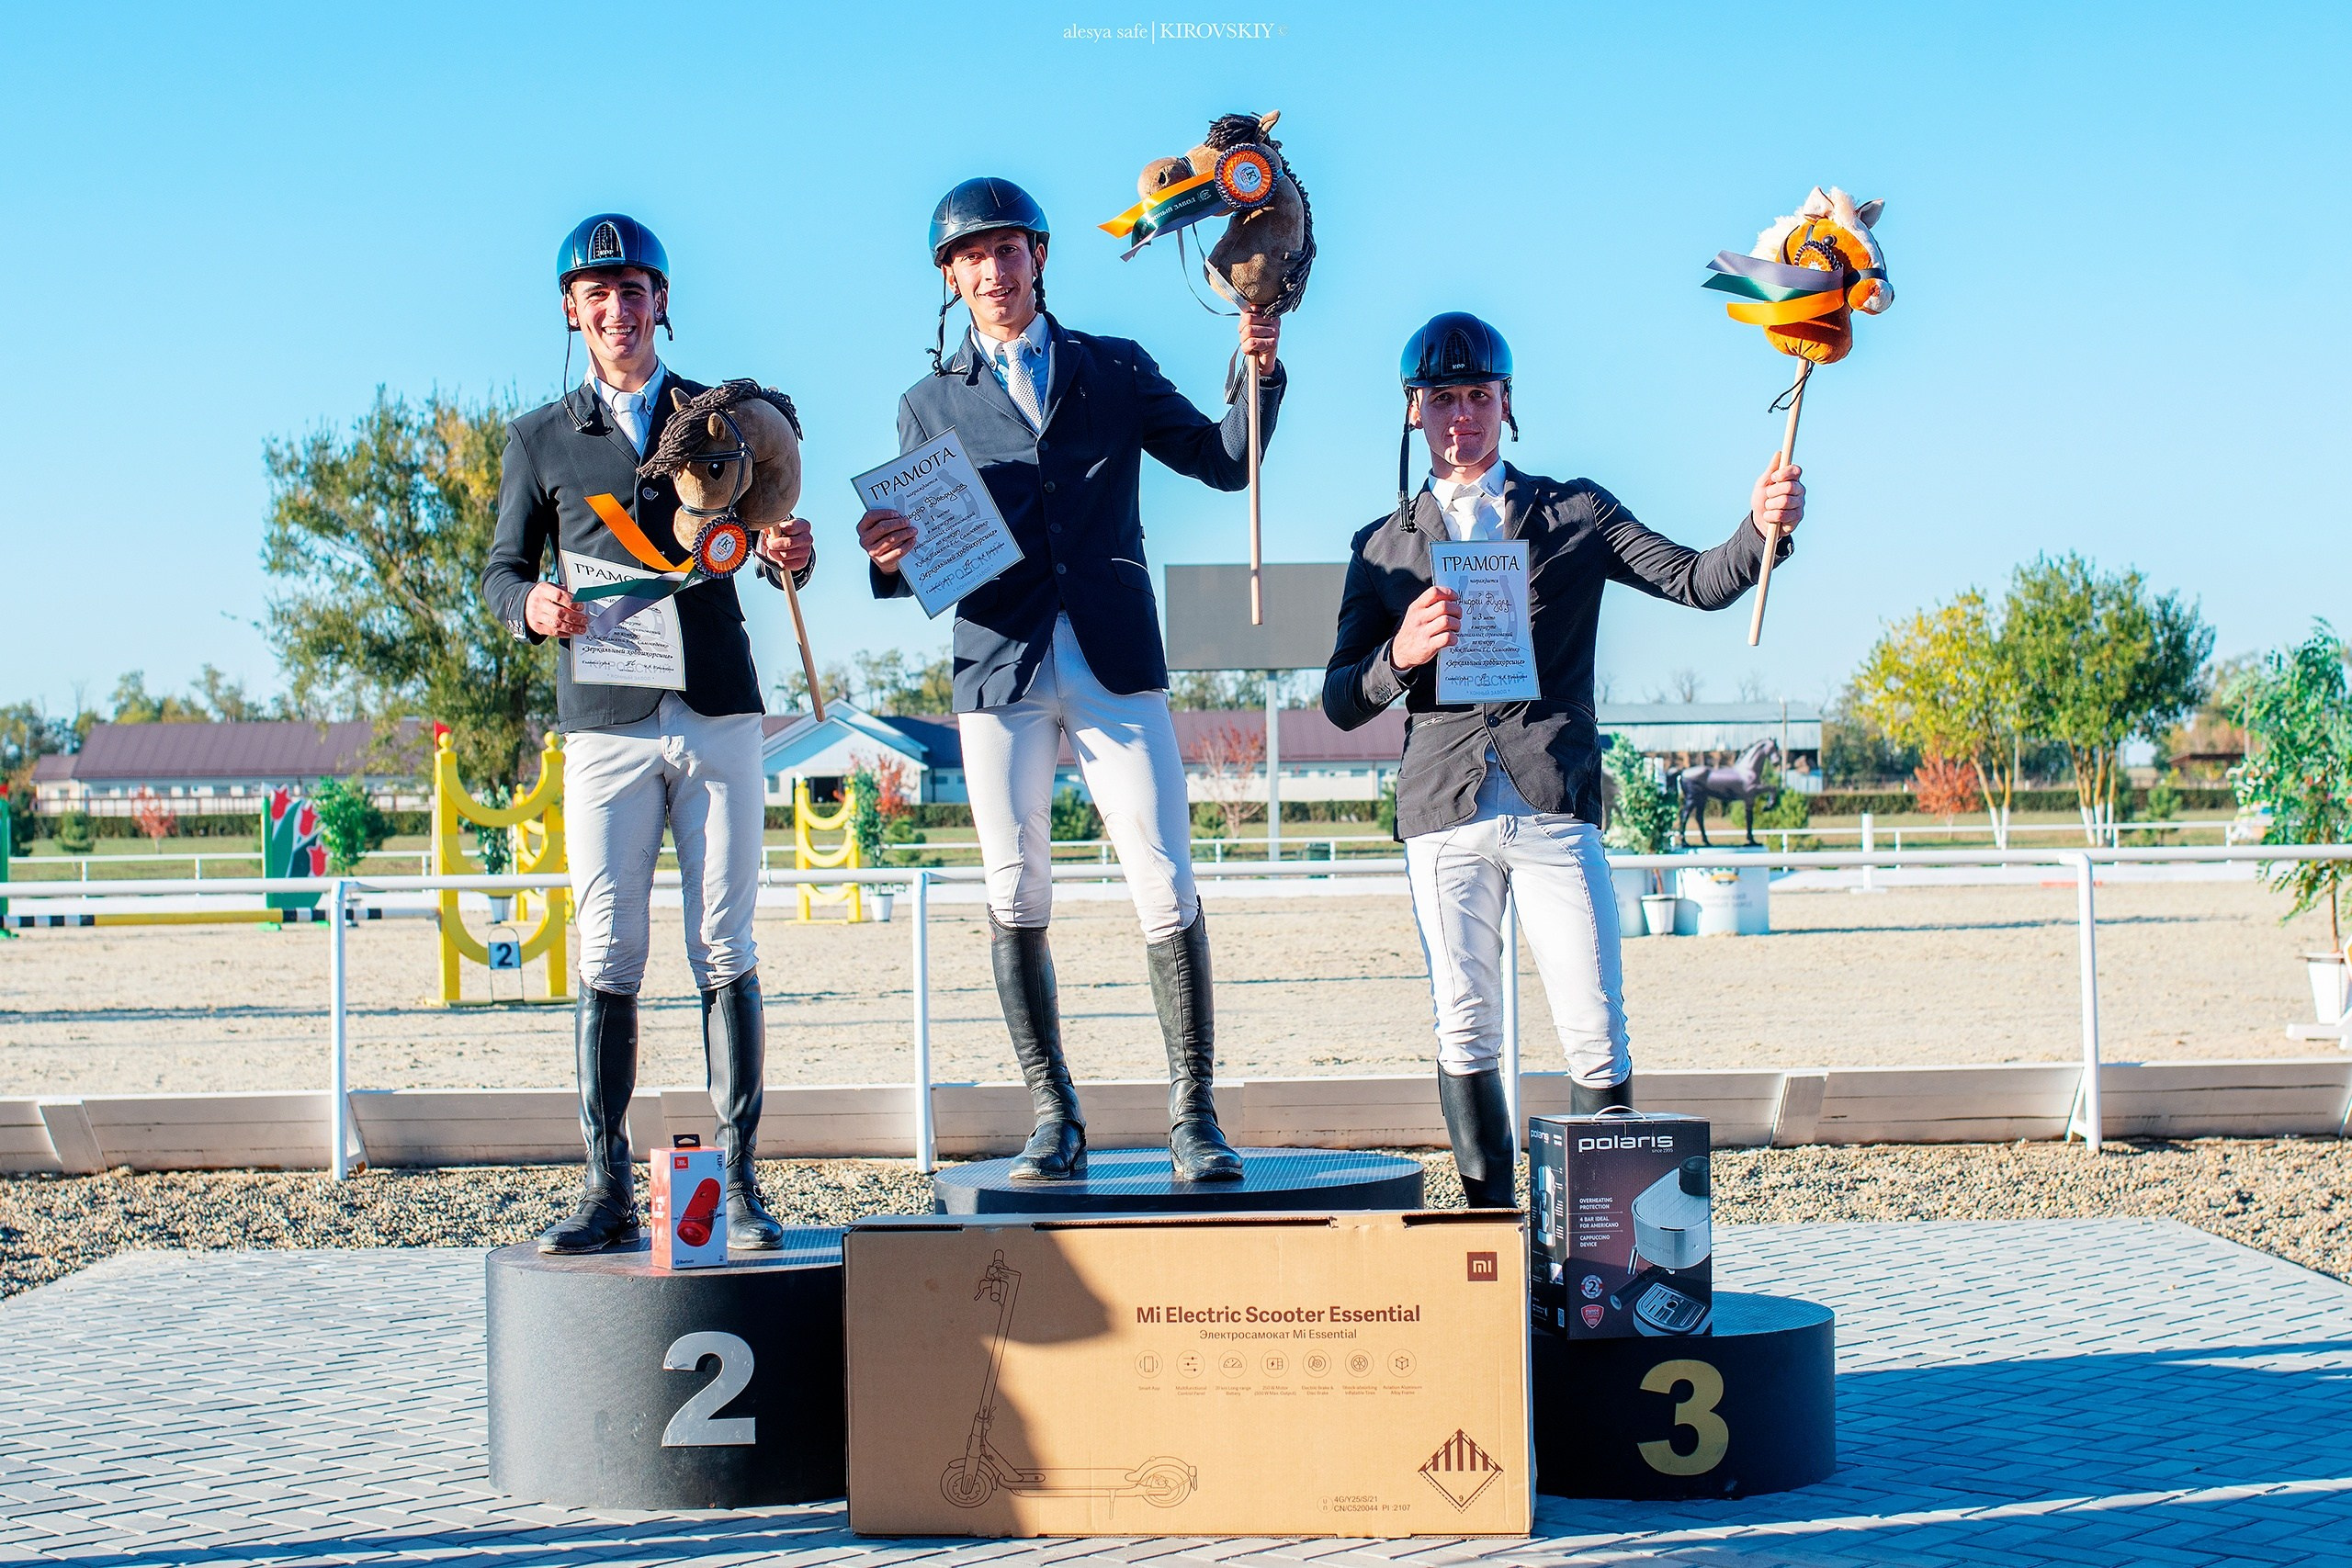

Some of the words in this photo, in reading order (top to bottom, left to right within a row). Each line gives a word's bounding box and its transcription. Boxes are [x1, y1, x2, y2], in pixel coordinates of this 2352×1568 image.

[869, 446, 956, 501] ГРАМОТА
[574, 563, 636, 582] ГРАМО
[1442, 555, 1521, 571] ГРАМОТА
[497, 942, 513, 966] 2
[1578, 1135, 1673, 1152] polaris
[1589, 1280, 1597, 1292] 2
[1136, 1306, 1160, 1323] Mi
[1166, 1305, 1241, 1323] Electric
[1246, 1306, 1325, 1323] Scooter
[1329, 1304, 1420, 1323] Essential
[1200, 1329, 1290, 1341] Электросамокат
[1293, 1329, 1306, 1339] Mi
[1309, 1328, 1357, 1339] Essential
[662, 1331, 756, 1447] 2
[1637, 1359, 1729, 1476] 3
[1334, 1495, 1378, 1504] 4G/Y25/S/21
